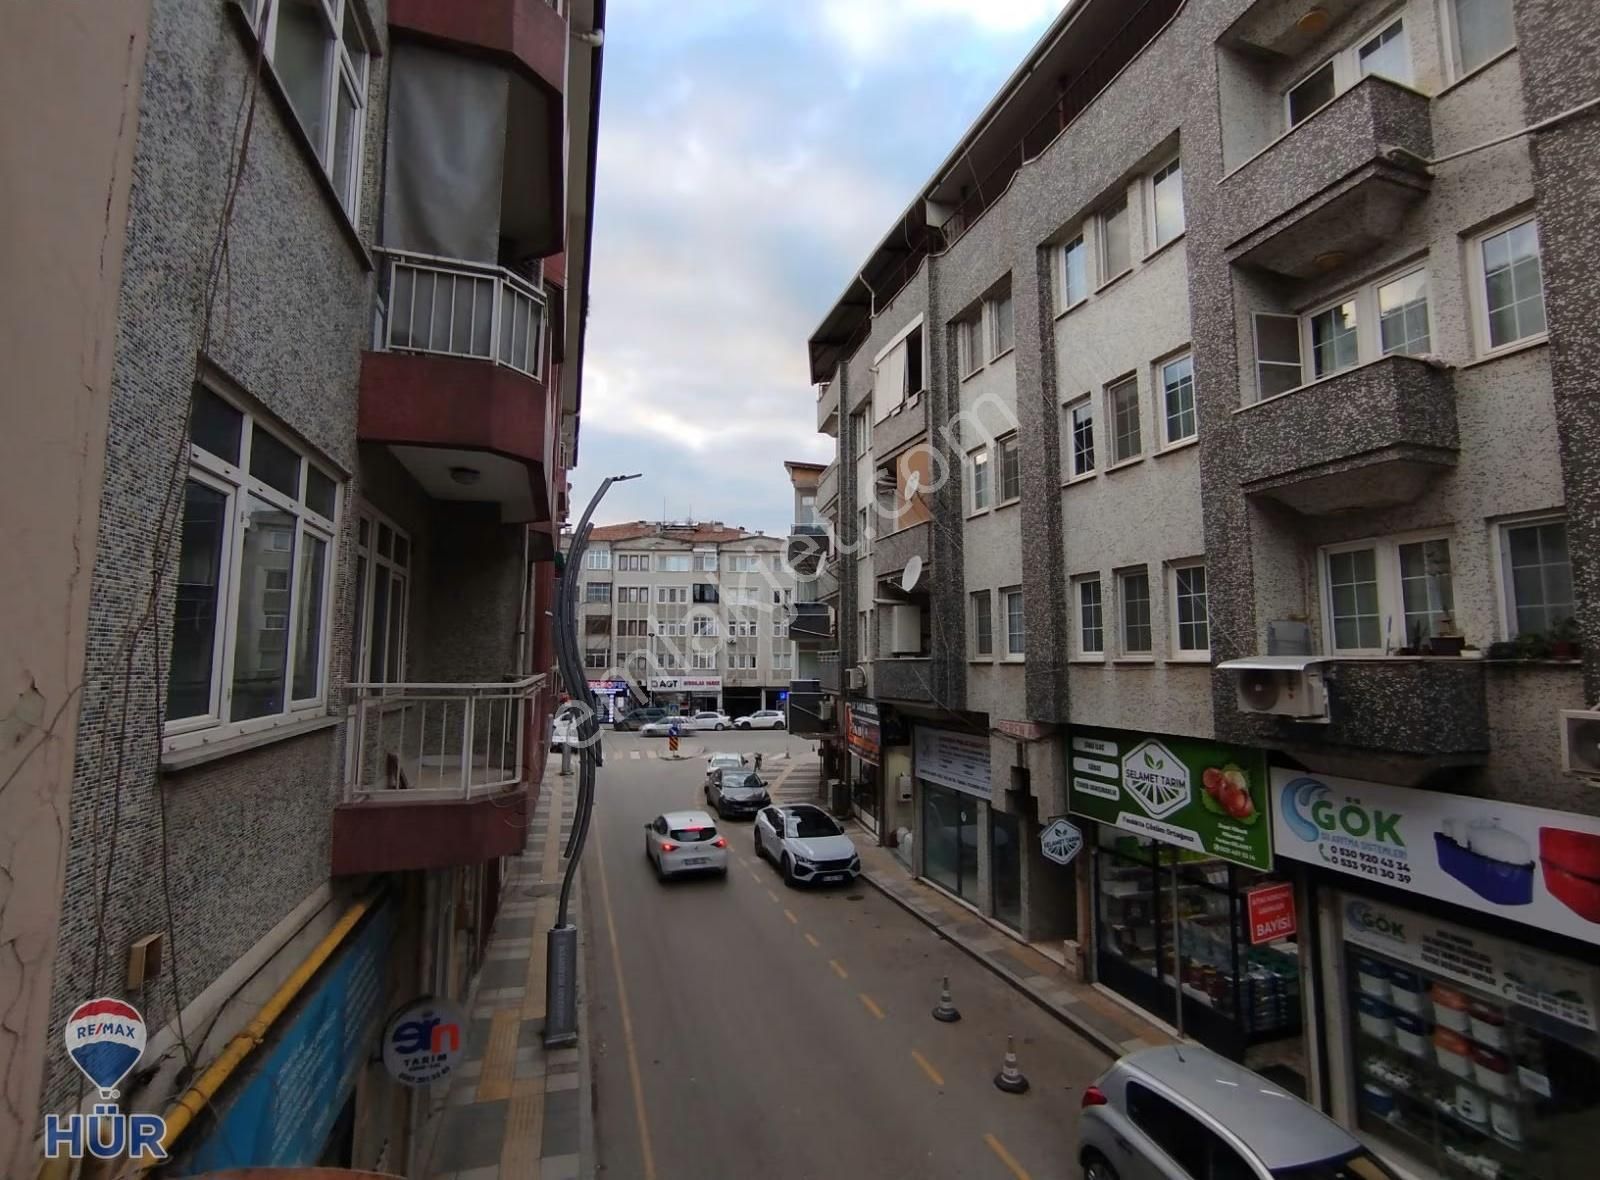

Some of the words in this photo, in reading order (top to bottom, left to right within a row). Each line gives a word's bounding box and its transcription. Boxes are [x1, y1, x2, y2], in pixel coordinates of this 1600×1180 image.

[1126, 769, 1159, 784] SELAMET
[1160, 776, 1186, 788] TARIM
[1312, 797, 1405, 847] GÖK
[1330, 846, 1338, 854] 0
[1340, 847, 1357, 858] 530
[1381, 858, 1394, 868] 43
[1331, 856, 1339, 864] 0
[1340, 859, 1358, 870] 533
[1360, 863, 1379, 875] 921
[1381, 868, 1395, 880] 30
[1397, 873, 1412, 884] 39
[1257, 912, 1292, 937] BAYİSİ
[1361, 911, 1406, 939] GÖK
[404, 1053, 448, 1067] TARIM
